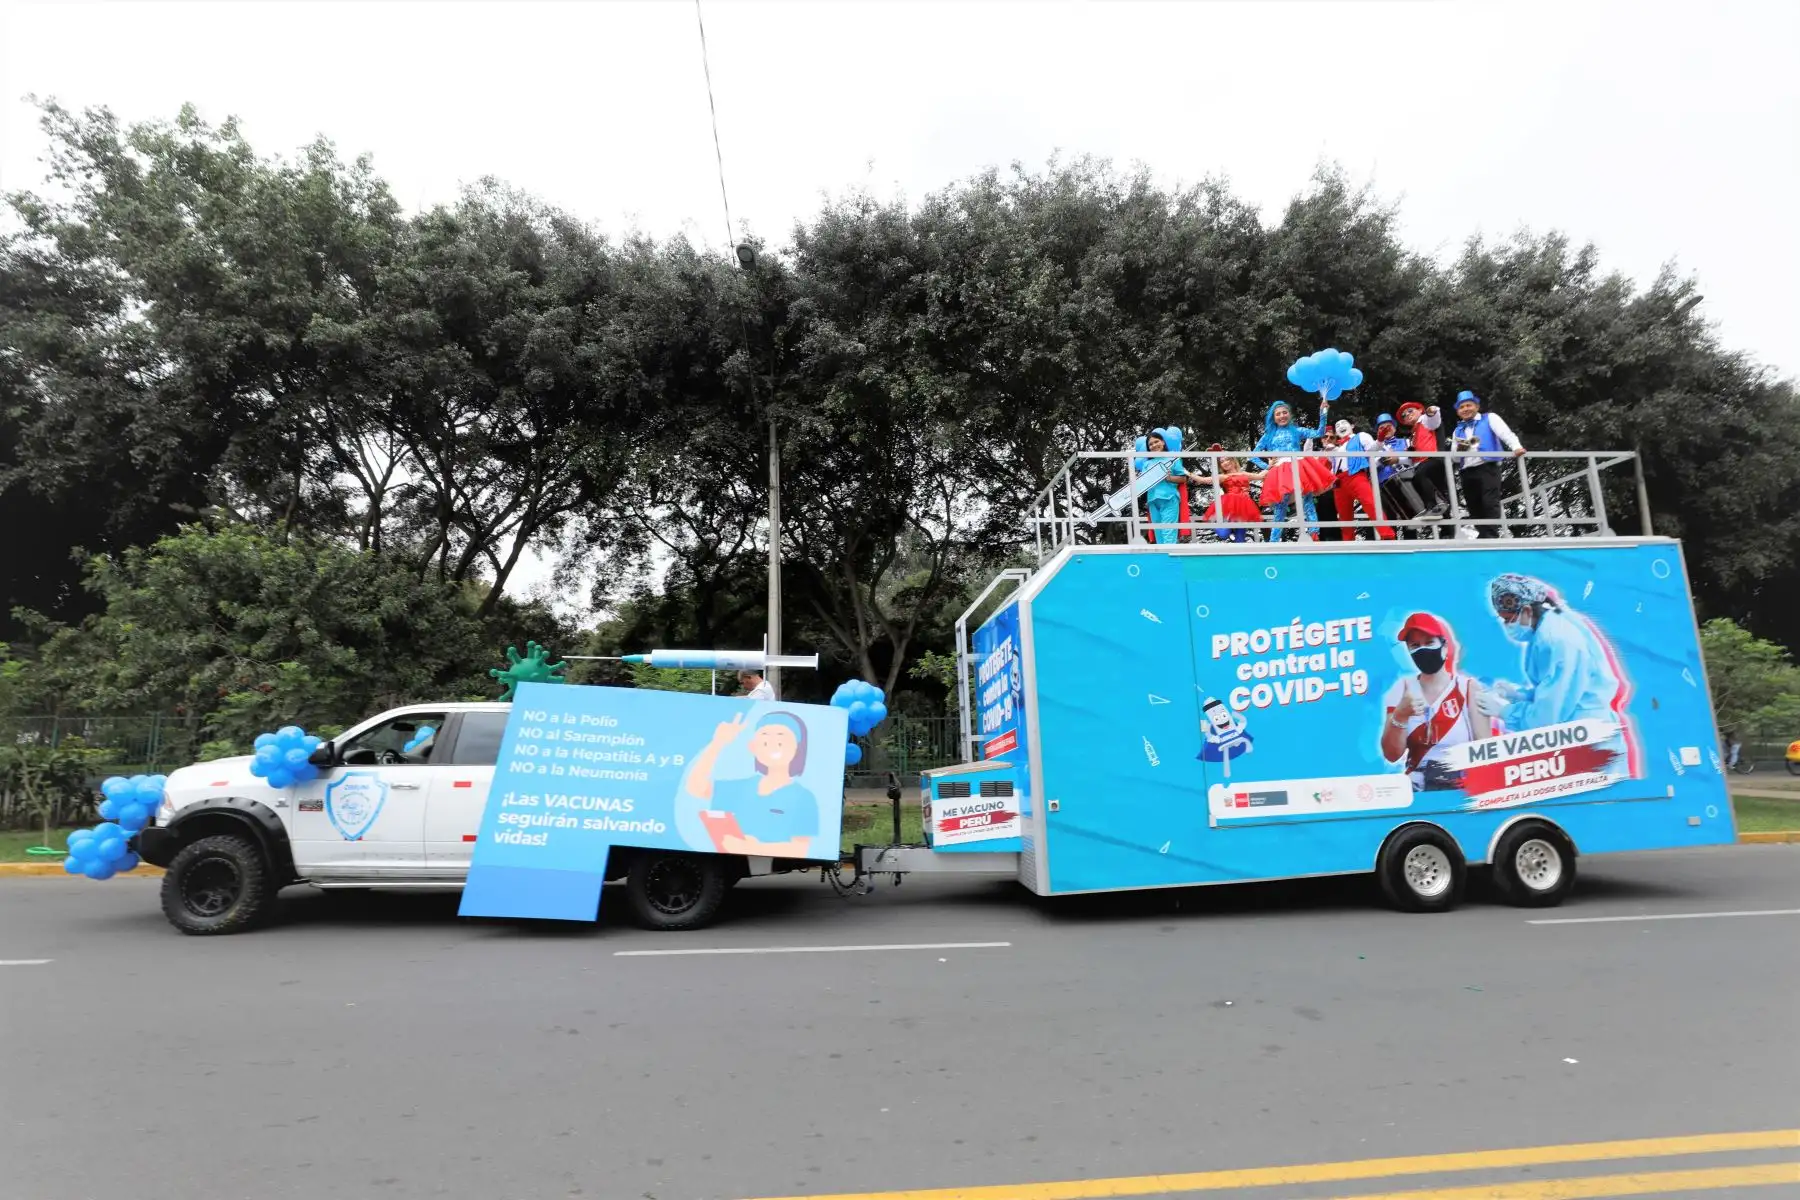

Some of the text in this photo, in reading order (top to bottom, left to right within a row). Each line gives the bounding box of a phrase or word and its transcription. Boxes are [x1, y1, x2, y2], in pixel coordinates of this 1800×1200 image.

[1211, 615, 1373, 660] PROTÉGETE
[1236, 647, 1355, 681] contra la
[1229, 669, 1369, 712] COVID-19
[523, 710, 618, 727] NO a la Polio
[518, 727, 645, 747] NO al Sarampión
[1468, 725, 1588, 763] ME VACUNO
[514, 744, 684, 767] NO a la Hepatitis A y B
[509, 761, 648, 781] NO a la Neumonía
[1504, 750, 1566, 786] PERÚ
[501, 791, 634, 813] ¡Las VACUNAS
[1478, 775, 1609, 808] COMPLETA LA DOSIS QUE TE FALTA
[942, 801, 1004, 818] ME VACUNO
[960, 812, 992, 829] PERÚ
[497, 811, 666, 834] seguirán salvando
[494, 829, 548, 846] vidas!
